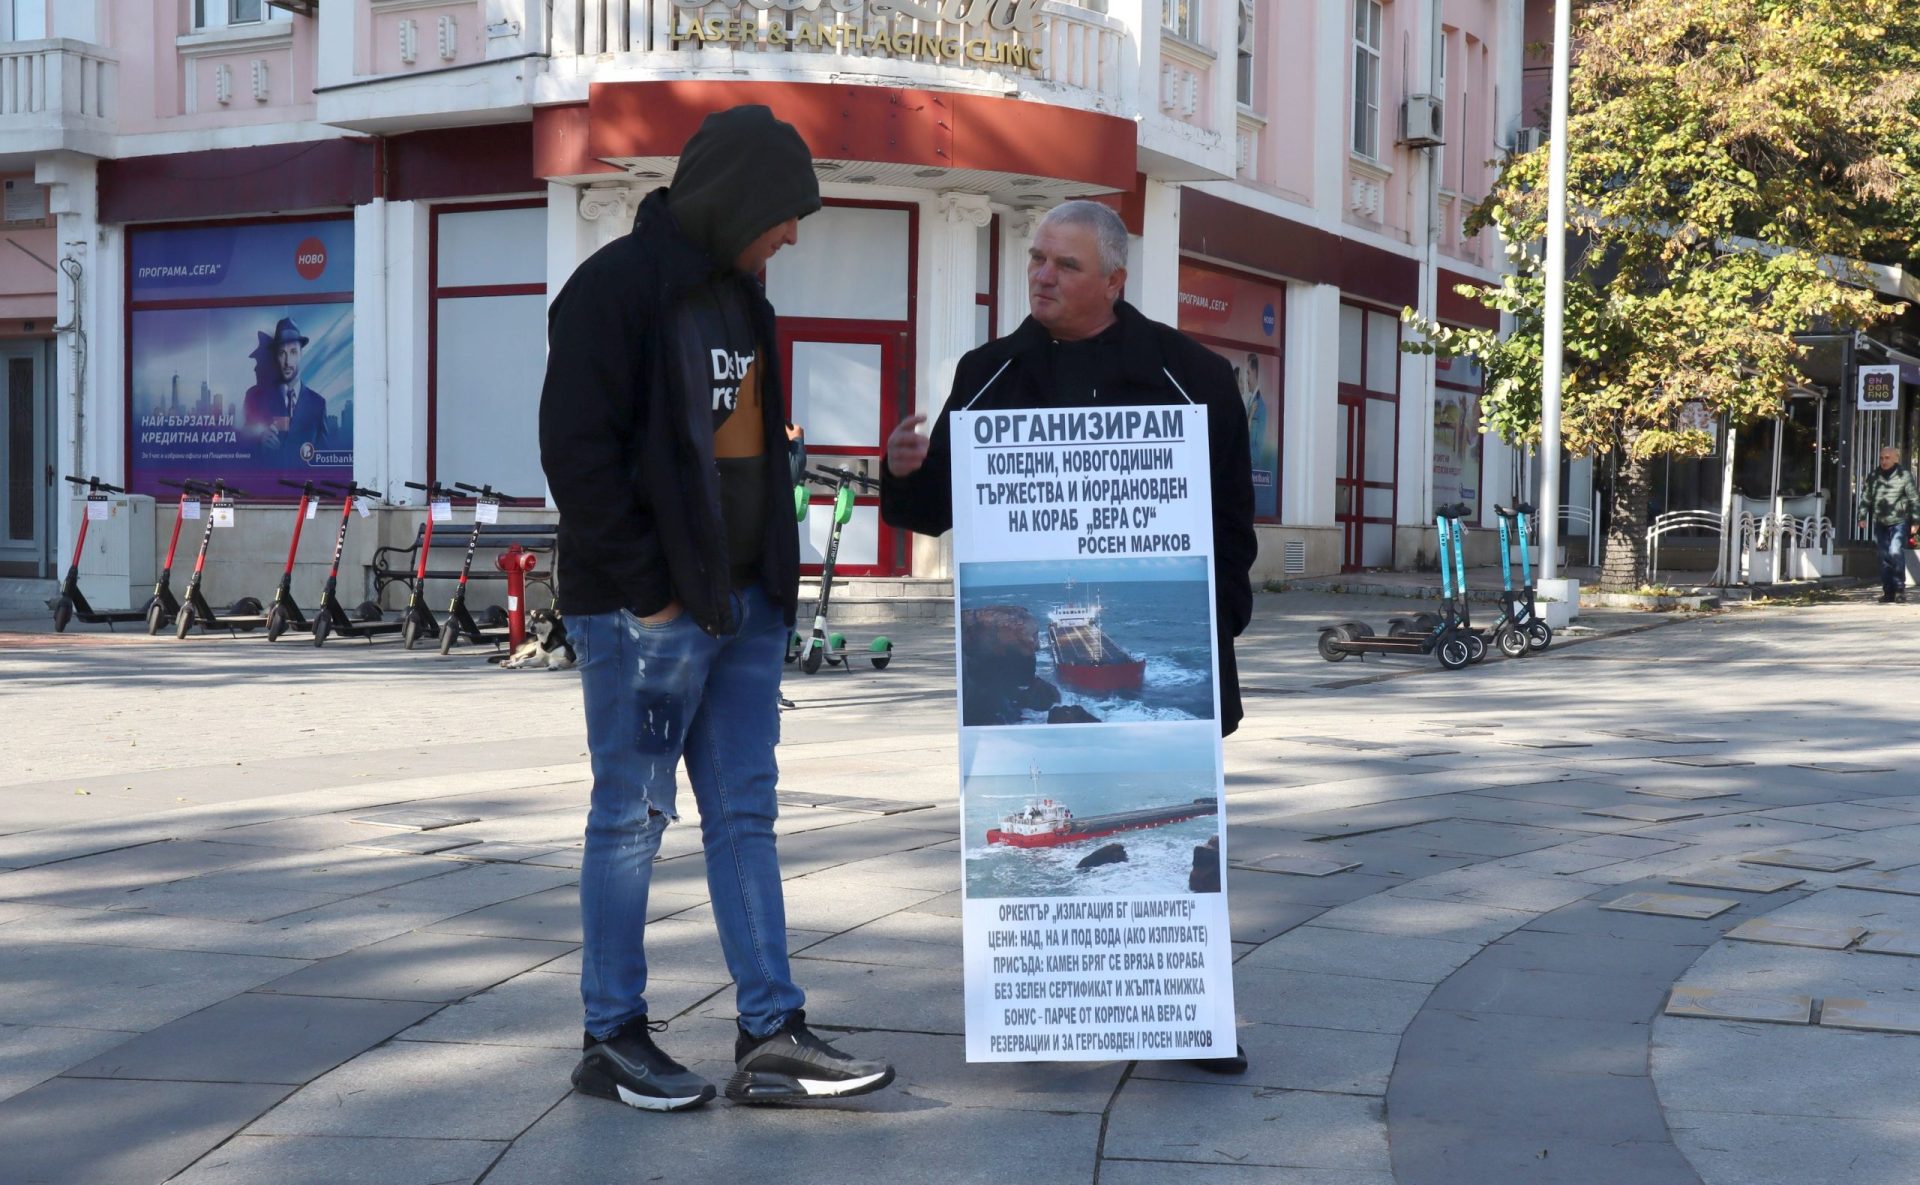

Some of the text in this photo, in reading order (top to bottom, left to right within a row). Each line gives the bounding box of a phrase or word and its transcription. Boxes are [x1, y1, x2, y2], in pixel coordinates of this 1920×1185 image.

[670, 17, 1043, 70] LASER & ANTI-AGING CLINIC
[298, 254, 324, 264] НОВО
[139, 266, 187, 278] ПРОГРАМА
[141, 413, 234, 427] НАЙ-БЪРЗАТА НИ
[974, 410, 1184, 444] ОРГАНИЗИРАМ
[141, 431, 237, 445] КРЕДИТНА КАРТА
[988, 448, 1173, 478] КОЛЕДНИ, НОВОГОДИШНИ
[976, 474, 1187, 505] ТЪРЖЕСТВА И ЙОРДАНОВДЕН
[1009, 507, 1156, 534] НА КОРАБ „ВЕРА СУ“
[1078, 534, 1190, 554] РОСЕН МАРКОВ
[999, 900, 1195, 923] ОРКЕКТЪР „ИЗЛАГАЦИЯ БГ (ШАМАРИТЕ)“
[989, 926, 1207, 950] ЦЕНИ: НАД, НА И ПОД ВОДА (АКО ИЗПЛУВАТЕ)
[994, 952, 1204, 976] ПРИСЪДА: КАМЕН БРЯГ СЕ ВРЯЗА В КОРАБА
[995, 978, 1205, 999] БЕЗ ЗЕЛЕН СЕРТИФИКАТ И ЖЪЛТА КНИЖКА
[1005, 1008, 1036, 1025] БОНУС
[1045, 1007, 1076, 1024] ПАРЧЕ
[1079, 1007, 1092, 1024] ОТ
[1095, 1006, 1139, 1023] КОРПУСА
[1142, 1005, 1155, 1022] НА
[1158, 1005, 1182, 1022] ВЕРА
[1185, 1004, 1196, 1021] СУ
[991, 1034, 1050, 1054] РЕЗЕРВАЦИИ
[1053, 1034, 1059, 1050] И
[1062, 1034, 1073, 1050] ЗА
[1076, 1032, 1134, 1052] ГЕРГЬОВДЕН
[1142, 1031, 1172, 1048] РОСЕН
[1175, 1030, 1212, 1047] МАРКОВ
